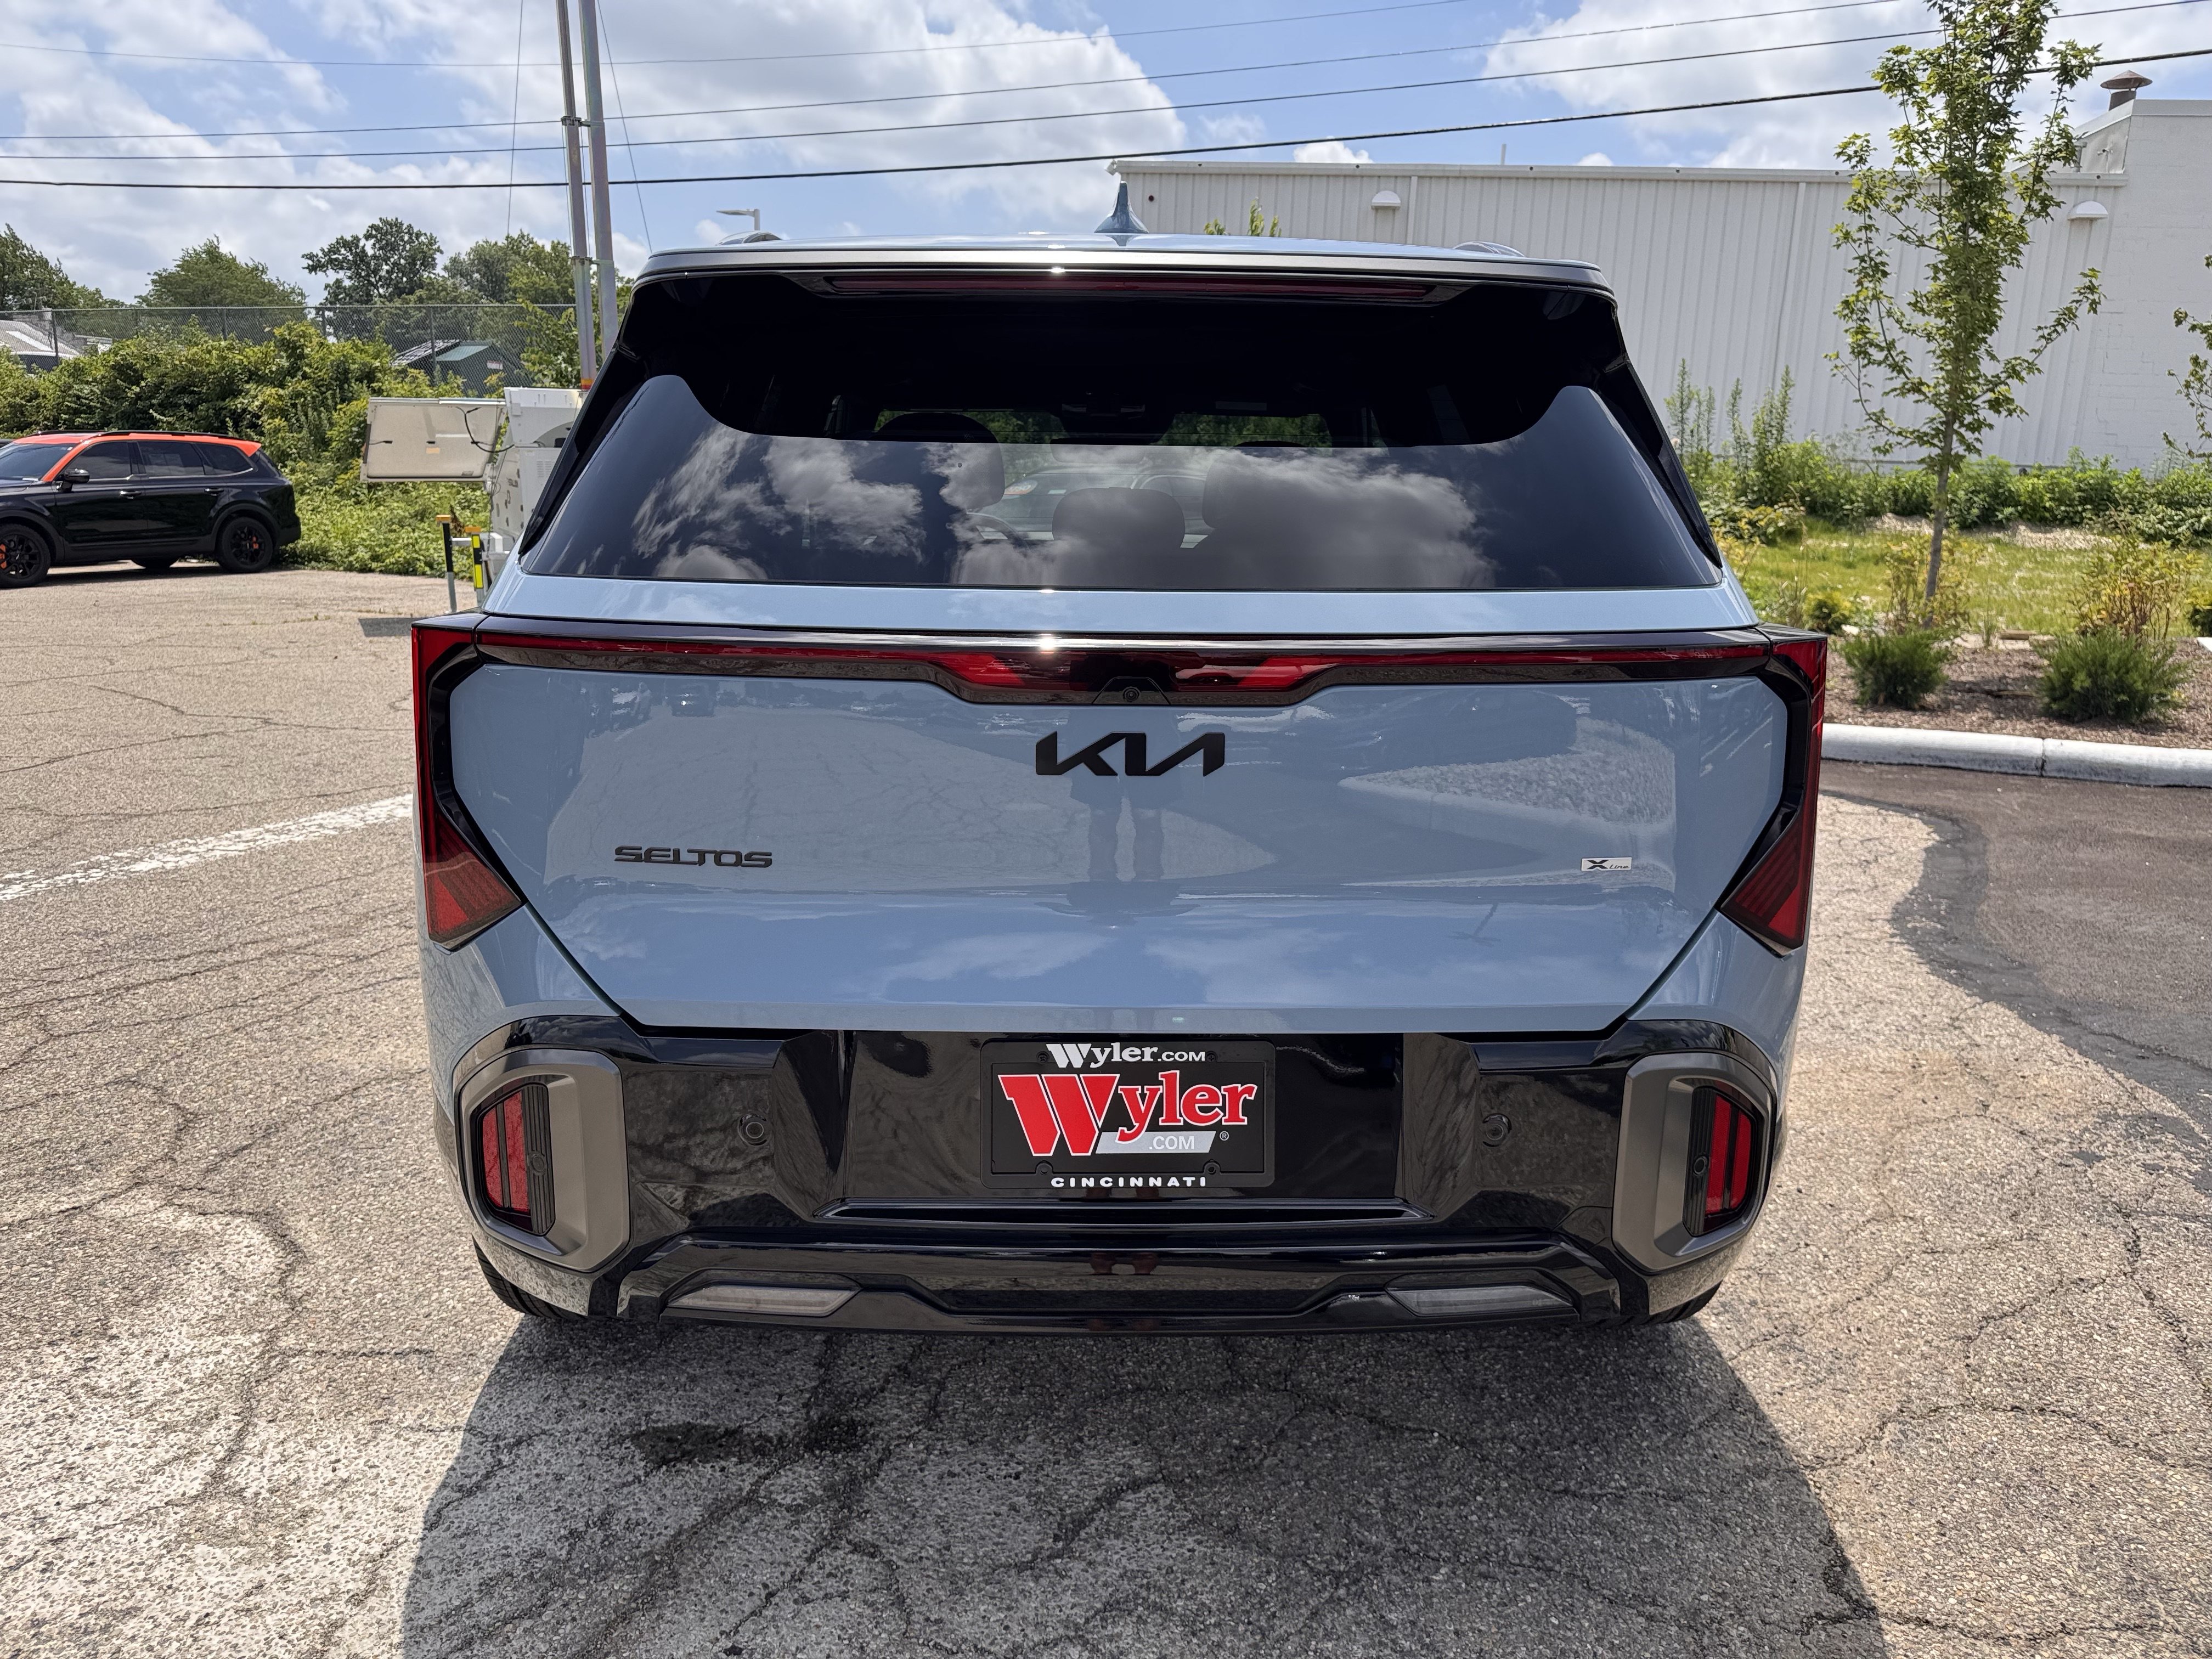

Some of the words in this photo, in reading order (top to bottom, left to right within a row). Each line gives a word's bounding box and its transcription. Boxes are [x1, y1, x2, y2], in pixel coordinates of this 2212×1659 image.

[614, 845, 772, 868] SELTOS
[1586, 859, 1610, 870] X
[997, 1070, 1258, 1156] Wyler
[1149, 1136, 1195, 1150] .COM
[1051, 1177, 1206, 1187] CINCINNATI
